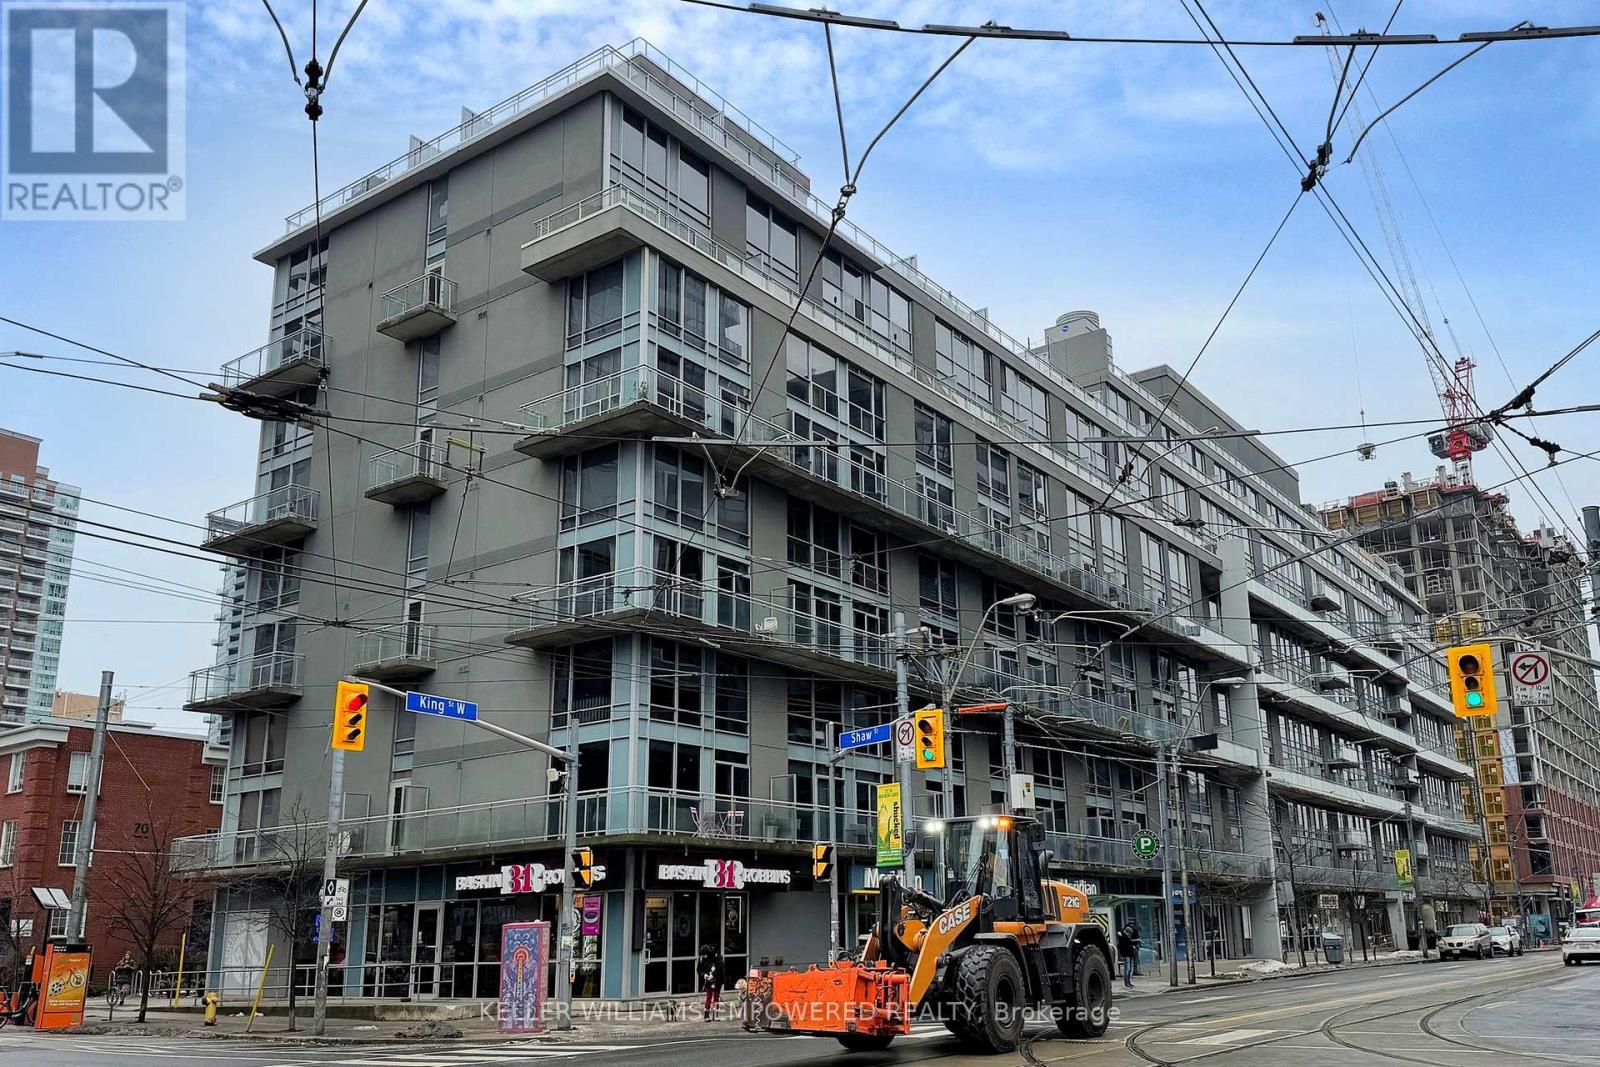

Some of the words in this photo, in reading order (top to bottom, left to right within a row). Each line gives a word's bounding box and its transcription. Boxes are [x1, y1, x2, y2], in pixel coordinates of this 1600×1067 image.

[420, 695, 445, 714] King
[457, 702, 466, 715] W
[851, 730, 872, 744] Shaw
[133, 823, 149, 834] 70
[455, 873, 501, 891] BASKIN
[658, 864, 707, 881] BASKIN
[742, 867, 791, 884] ROBBINS
[939, 902, 971, 934] CASE
